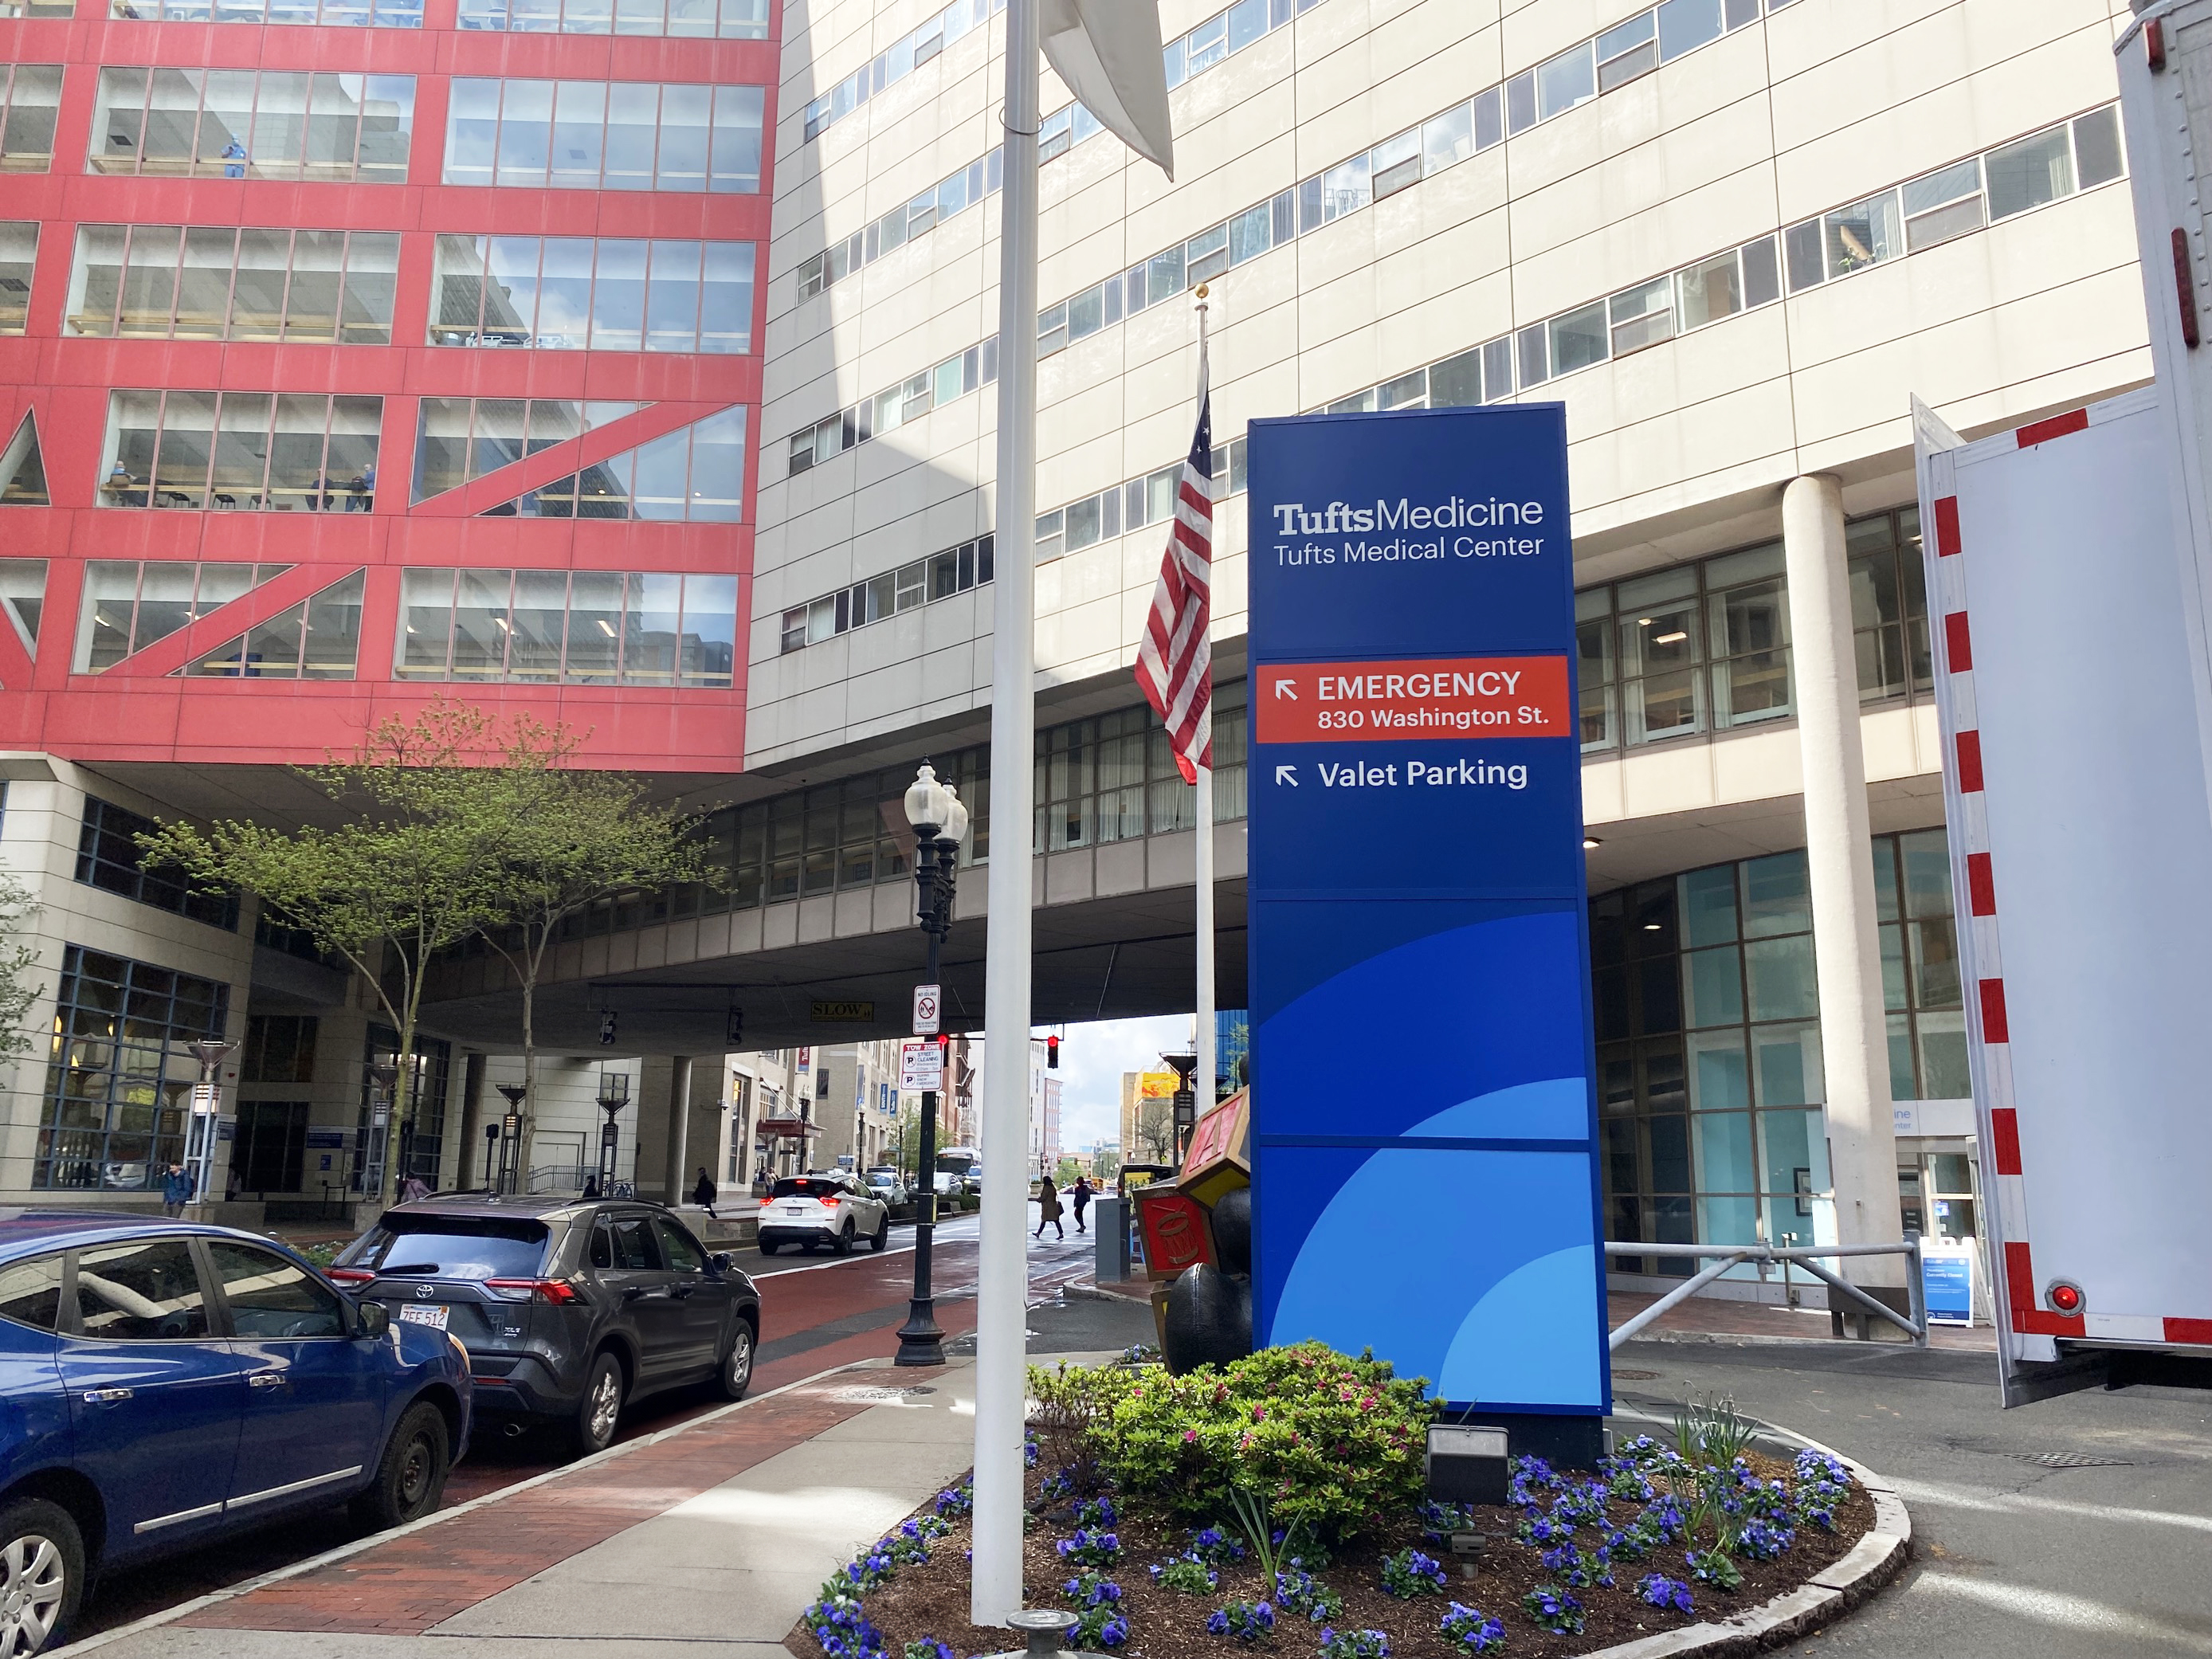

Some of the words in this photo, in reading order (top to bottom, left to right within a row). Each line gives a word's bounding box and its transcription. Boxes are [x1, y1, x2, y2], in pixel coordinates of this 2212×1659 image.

[1273, 496, 1543, 535] TuftsMedicine
[1273, 543, 1336, 566] Tufts
[1344, 536, 1445, 563] Medical
[1454, 536, 1545, 558] Center
[1318, 671, 1521, 700] EMERGENCY
[1317, 710, 1364, 729] 830
[1371, 707, 1511, 730] Washington
[1517, 705, 1550, 724] St.
[1317, 760, 1398, 787] Valet
[1406, 759, 1528, 790] Parking
[813, 1003, 862, 1015] SLOW
[1894, 1109, 1911, 1119] ine
[424, 1312, 445, 1326] 512
